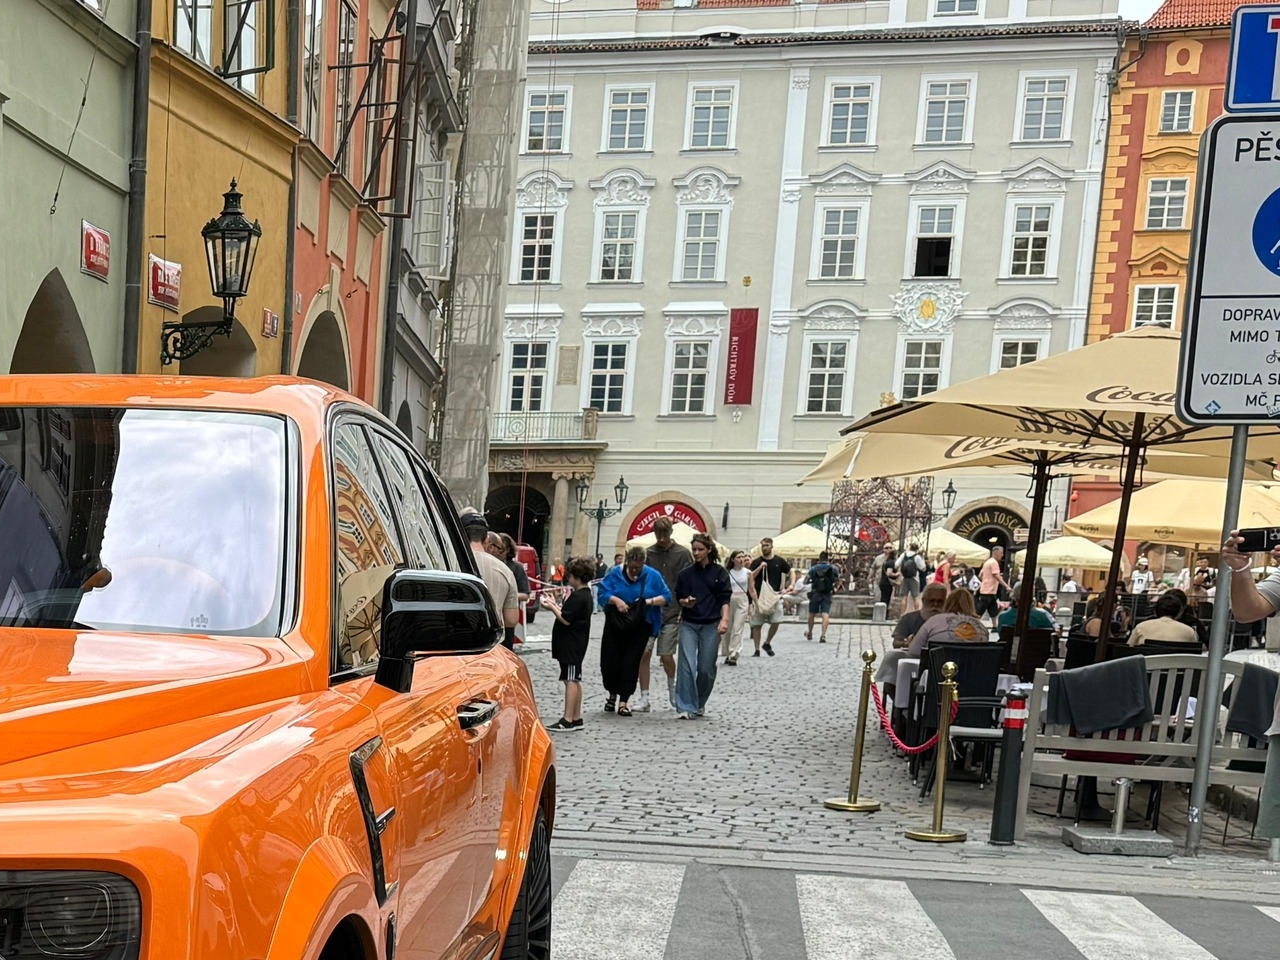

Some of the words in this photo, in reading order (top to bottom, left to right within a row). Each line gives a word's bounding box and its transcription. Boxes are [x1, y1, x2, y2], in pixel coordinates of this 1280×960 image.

[1229, 330, 1269, 342] MIMO
[1201, 373, 1263, 385] VOZIDLA
[1268, 373, 1280, 385] S
[1245, 391, 1268, 407] MČ
